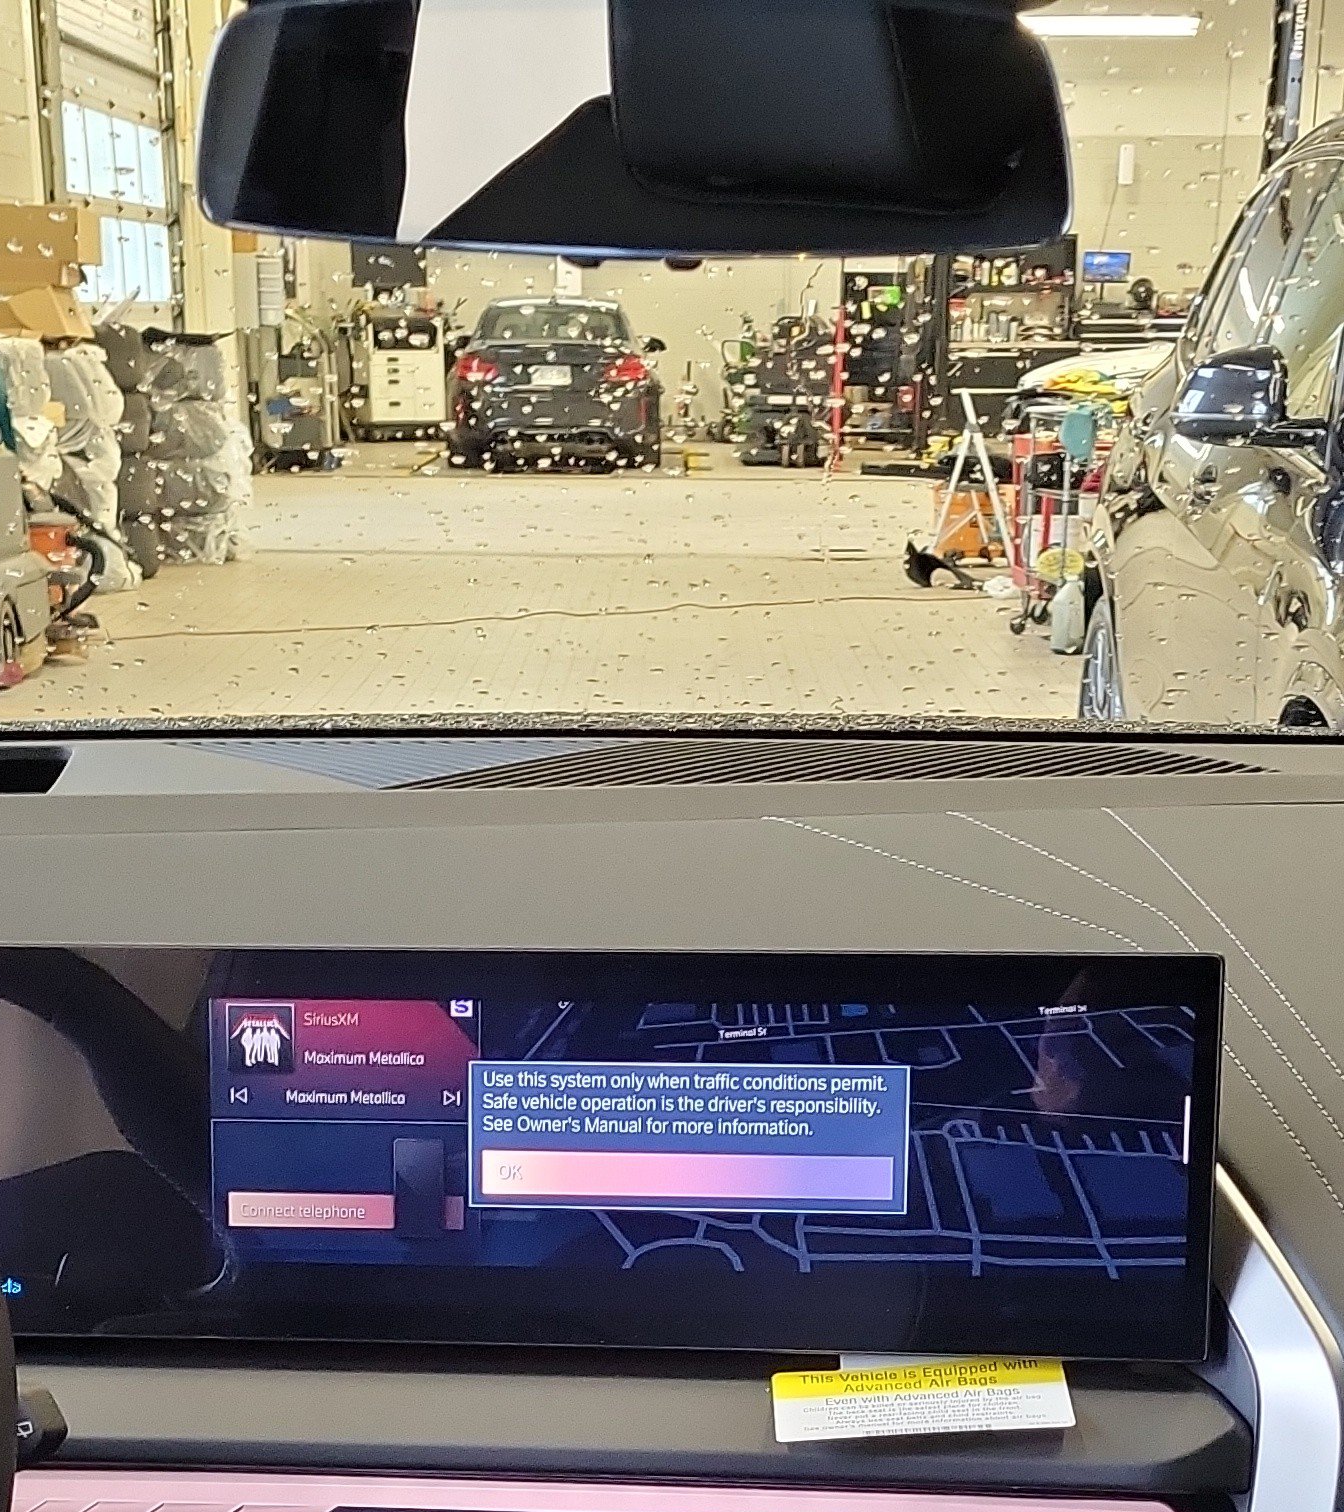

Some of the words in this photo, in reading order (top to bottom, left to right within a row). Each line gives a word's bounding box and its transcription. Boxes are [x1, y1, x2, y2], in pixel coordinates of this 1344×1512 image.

[303, 1011, 359, 1027] SiriusXM
[718, 1028, 757, 1039] Terminal
[304, 1051, 366, 1065] Maximum
[369, 1052, 425, 1066] Metallica
[483, 1070, 514, 1087] Use
[517, 1071, 547, 1087] this
[550, 1072, 606, 1091] system
[610, 1072, 644, 1092] only
[646, 1073, 690, 1089] when
[694, 1073, 739, 1090] traffic
[743, 1073, 827, 1091] conditions
[831, 1075, 888, 1094] permit.
[286, 1090, 348, 1105] Maximum
[350, 1090, 406, 1105] Metallica
[483, 1092, 517, 1110] Safe
[521, 1094, 577, 1111] vehicle
[581, 1095, 656, 1113] operation
[661, 1095, 674, 1112] is
[677, 1096, 704, 1112] the
[708, 1096, 766, 1112] driver's
[770, 1098, 881, 1117] responsibility.
[483, 1115, 513, 1132] See
[517, 1116, 581, 1133] Owner's
[585, 1117, 642, 1133] Manual
[646, 1117, 669, 1134] for
[672, 1120, 713, 1134] more
[718, 1118, 814, 1136] information.
[499, 1165, 523, 1181] OK
[240, 1203, 295, 1217] Connect
[299, 1203, 366, 1220] telephone
[799, 1373, 833, 1385] This
[839, 1369, 897, 1383] Vehicle
[903, 1368, 916, 1378] is
[922, 1361, 998, 1378] Equipped
[1002, 1358, 1038, 1370] with
[843, 1379, 922, 1393] Advanced
[927, 1377, 952, 1387] Air
[957, 1374, 998, 1387] Bags
[825, 1396, 856, 1405] Even
[860, 1394, 889, 1403] with
[893, 1389, 958, 1402] Advanced
[962, 1388, 980, 1397] Air
[986, 1386, 1020, 1396] Bags
